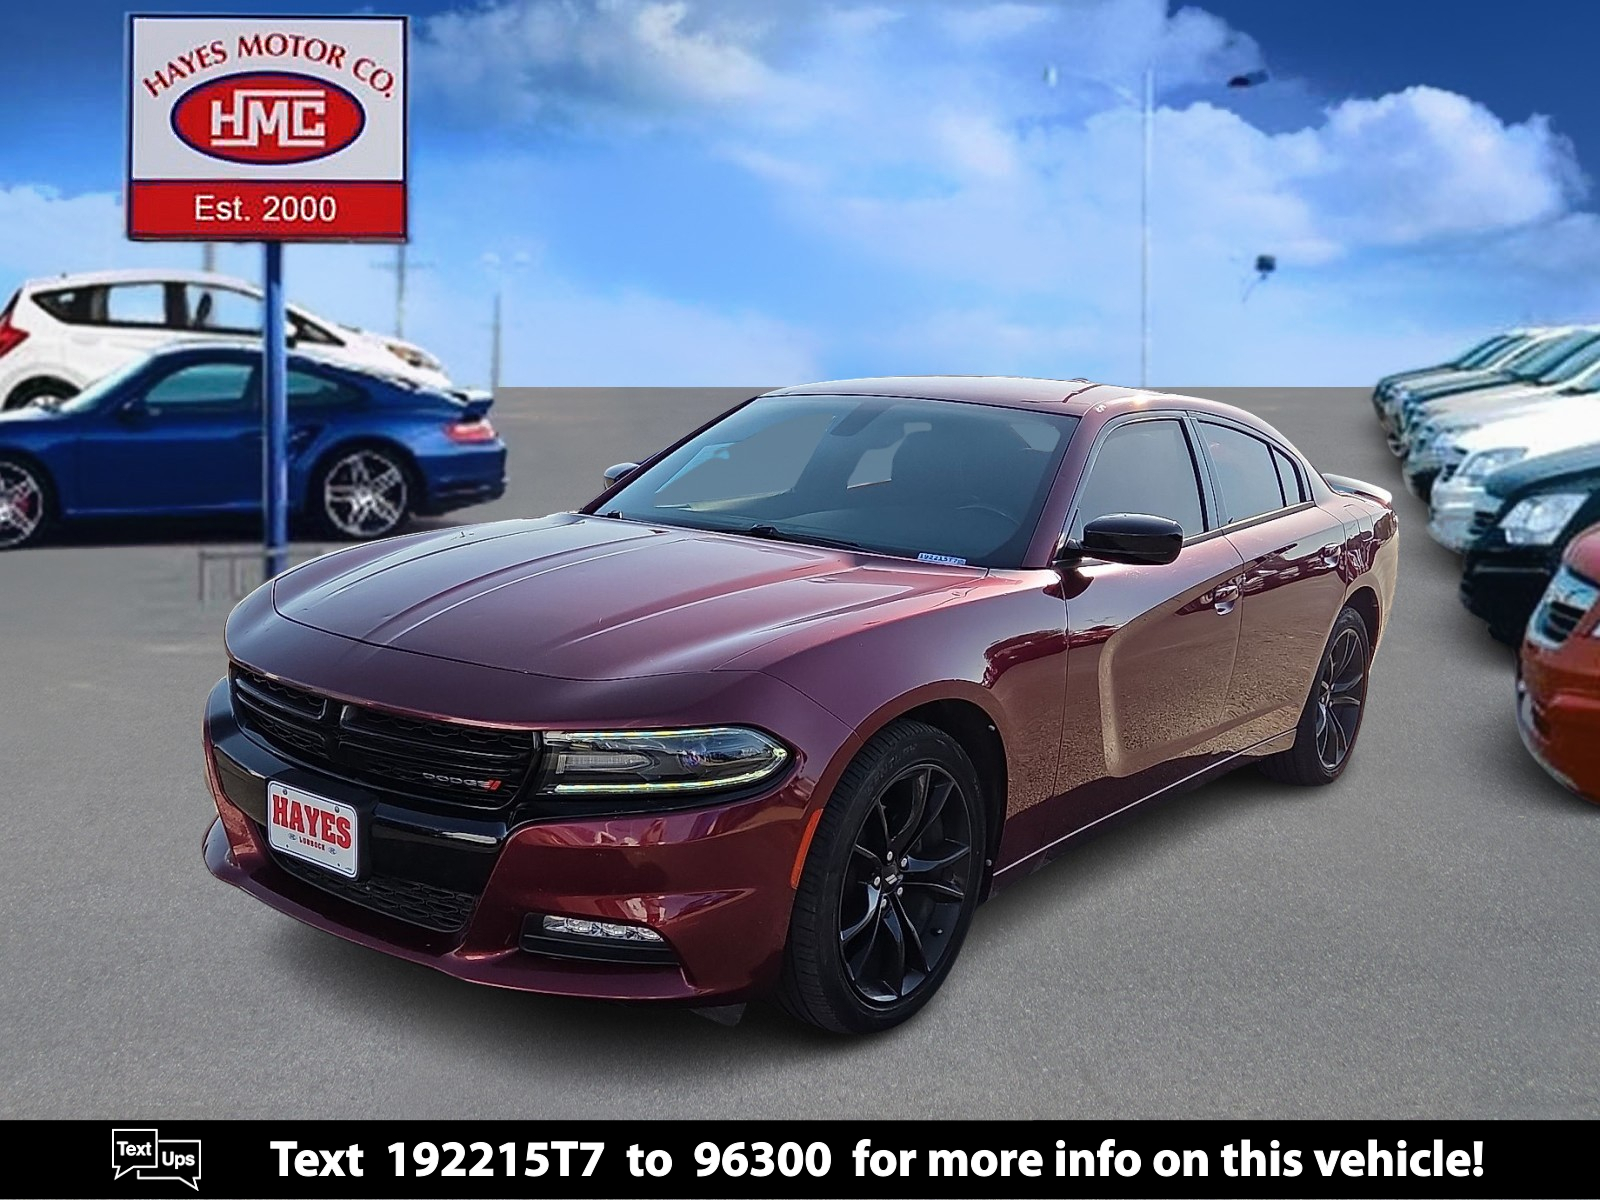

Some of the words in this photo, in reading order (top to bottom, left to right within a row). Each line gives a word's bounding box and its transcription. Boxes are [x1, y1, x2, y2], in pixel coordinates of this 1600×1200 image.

[142, 40, 228, 98] HAYES
[237, 32, 347, 69] MOTOR
[352, 57, 395, 98] CO.
[209, 88, 326, 147] HMC
[194, 194, 251, 222] Est.
[262, 194, 337, 222] 2000
[423, 772, 490, 788] DODGE
[272, 793, 352, 850] HAYES
[299, 836, 326, 850] LUBBOCK
